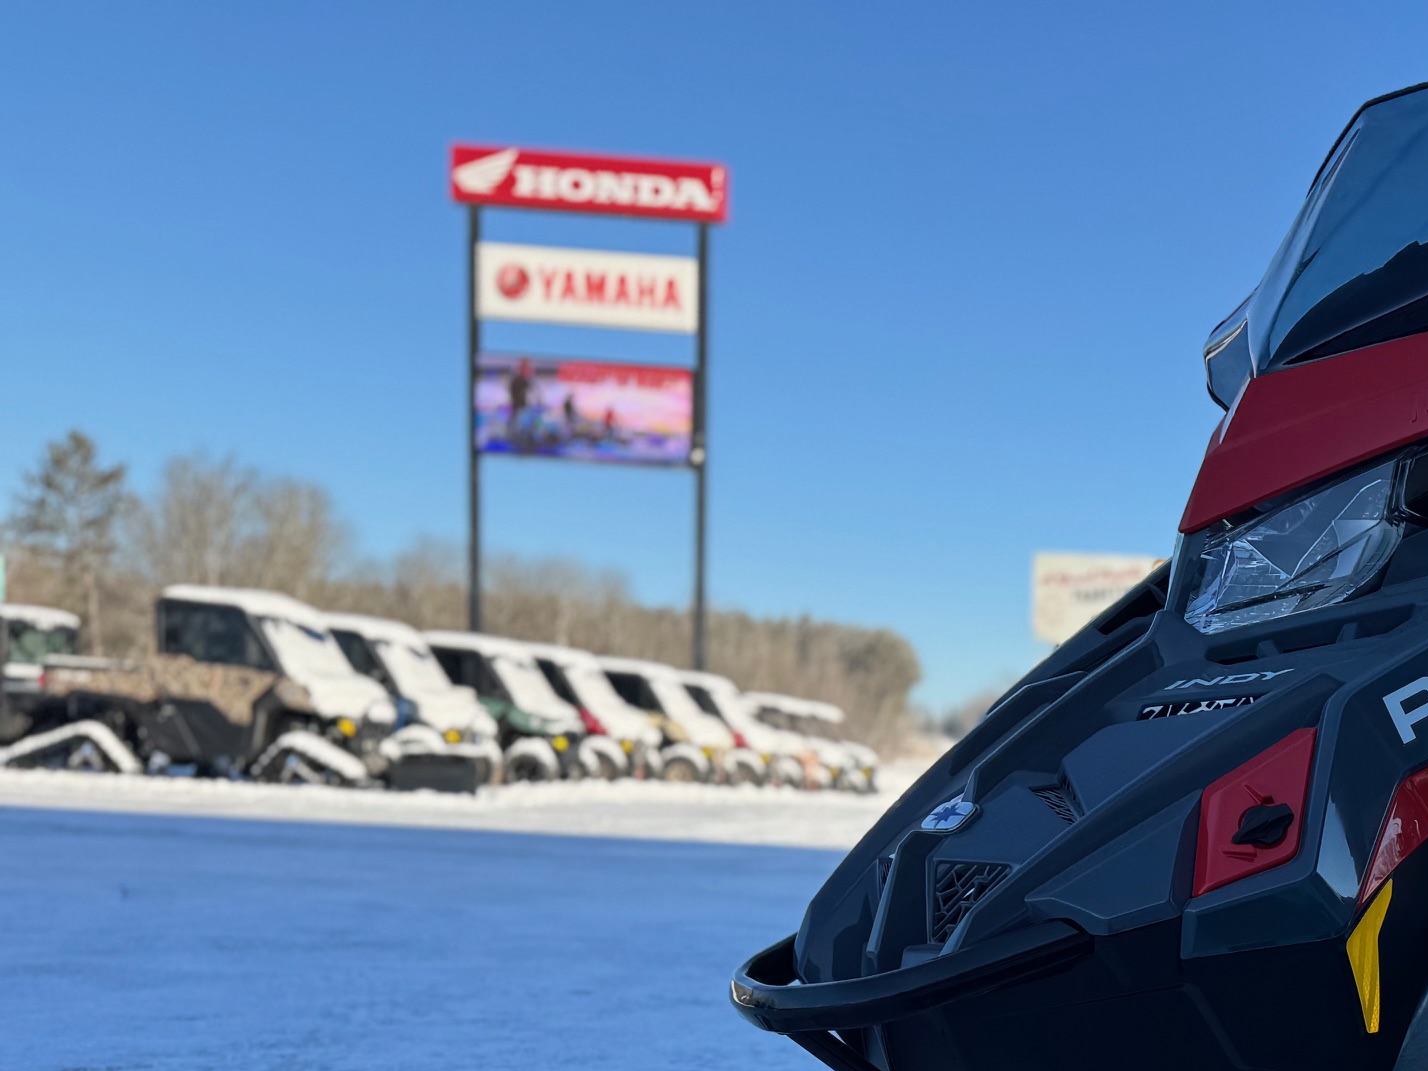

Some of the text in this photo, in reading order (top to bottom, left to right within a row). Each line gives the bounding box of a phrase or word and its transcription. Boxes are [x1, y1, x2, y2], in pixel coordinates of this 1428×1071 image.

[513, 164, 718, 212] HONDA
[541, 270, 681, 310] YAMAHA
[1164, 668, 1295, 690] INDY
